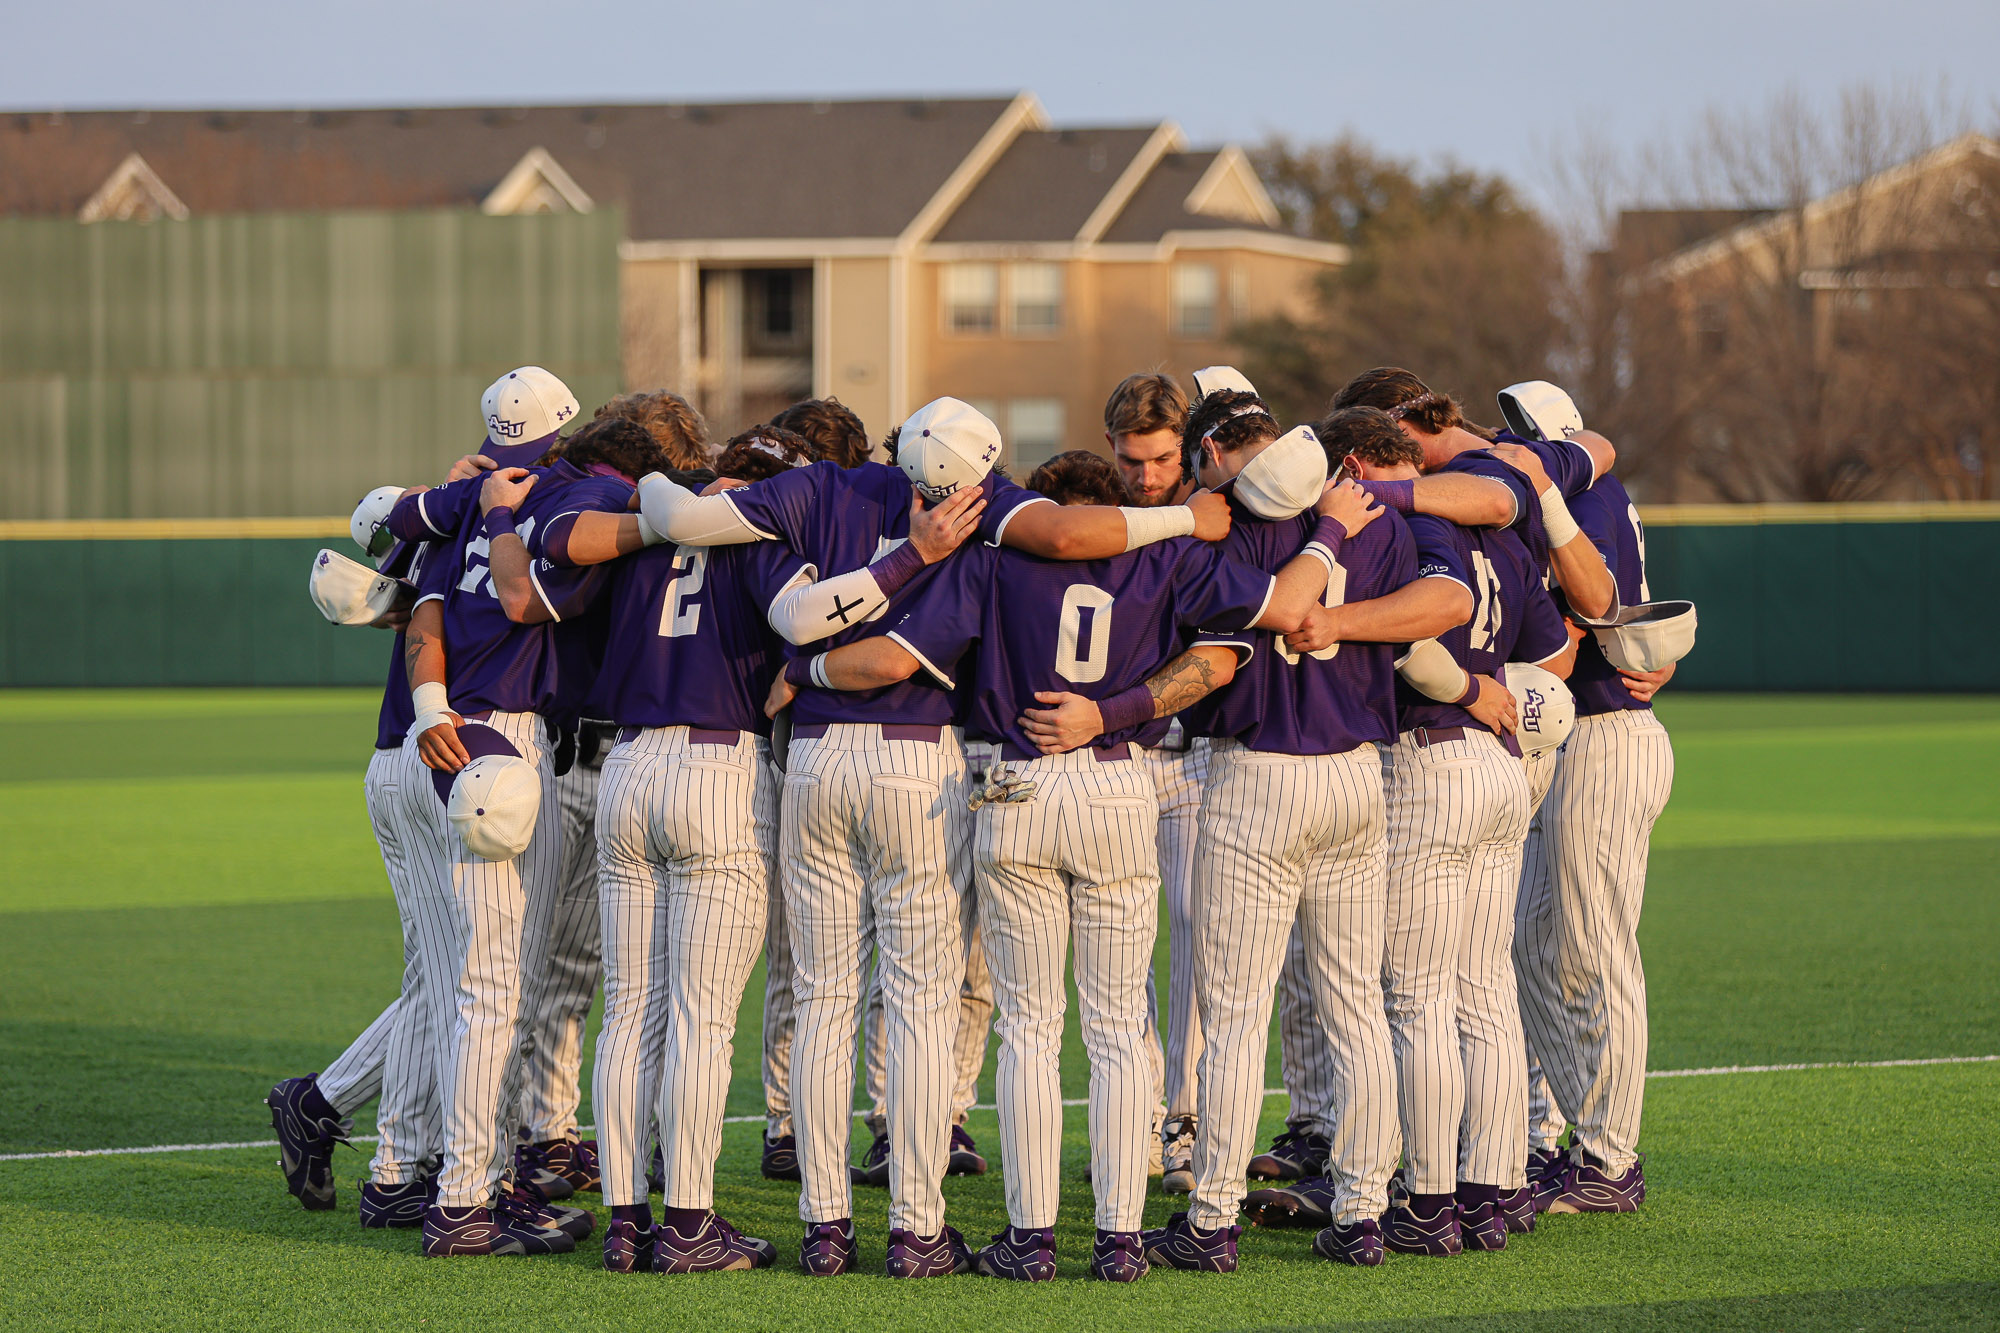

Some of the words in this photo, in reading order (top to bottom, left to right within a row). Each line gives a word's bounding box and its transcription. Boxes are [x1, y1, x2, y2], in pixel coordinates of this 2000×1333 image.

[488, 415, 527, 438] ACU
[658, 545, 710, 637] 2
[1055, 584, 1115, 683] 0
[1523, 688, 1545, 734] ACU
